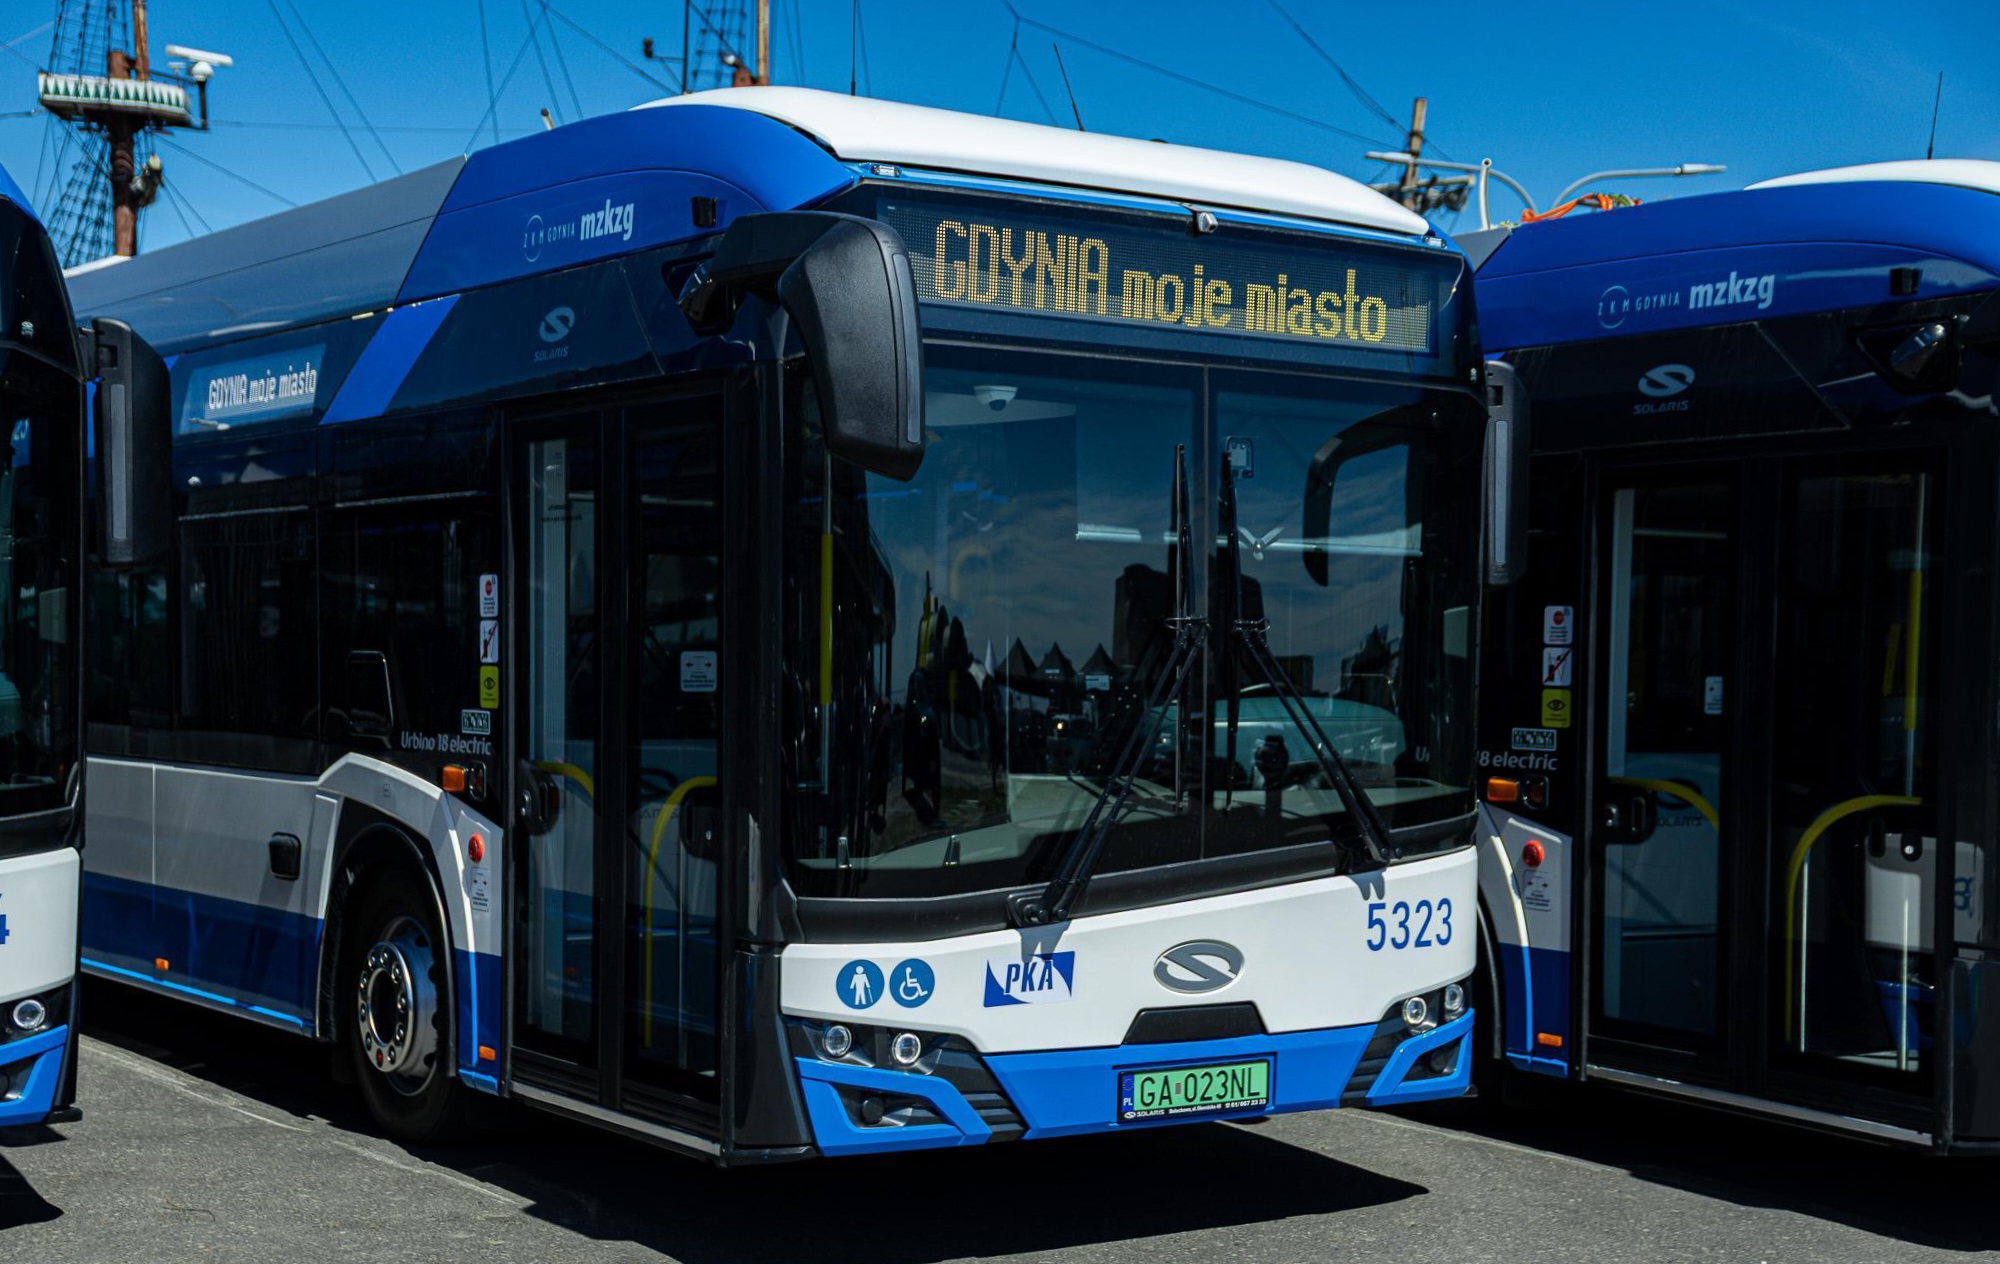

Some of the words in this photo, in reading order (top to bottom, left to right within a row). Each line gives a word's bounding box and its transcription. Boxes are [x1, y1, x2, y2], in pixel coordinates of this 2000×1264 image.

[547, 221, 576, 243] GDYNIA
[580, 198, 635, 241] mzkzg
[934, 220, 1109, 317] GDYNIA
[1122, 263, 1233, 329] moje
[1245, 269, 1387, 343] miasto
[1635, 291, 1681, 312] GDYNIA
[1688, 270, 1776, 310] mzkzg
[533, 346, 569, 362] SOLARIS
[208, 373, 248, 411] GDYNIA
[249, 368, 277, 404] moje
[278, 361, 318, 399] miasto
[1633, 400, 1690, 416] SOLARIS
[401, 730, 436, 751] Urbino
[437, 733, 449, 752] 18
[450, 735, 493, 756] electric
[1491, 751, 1560, 771] electric
[1366, 897, 1453, 952] 5323
[1005, 960, 1054, 994] PKA
[1123, 1097, 1134, 1107] PL
[1140, 1075, 1173, 1107] GA
[1184, 1067, 1260, 1103] 023NL
[1136, 1109, 1165, 1118] SOLARIS
